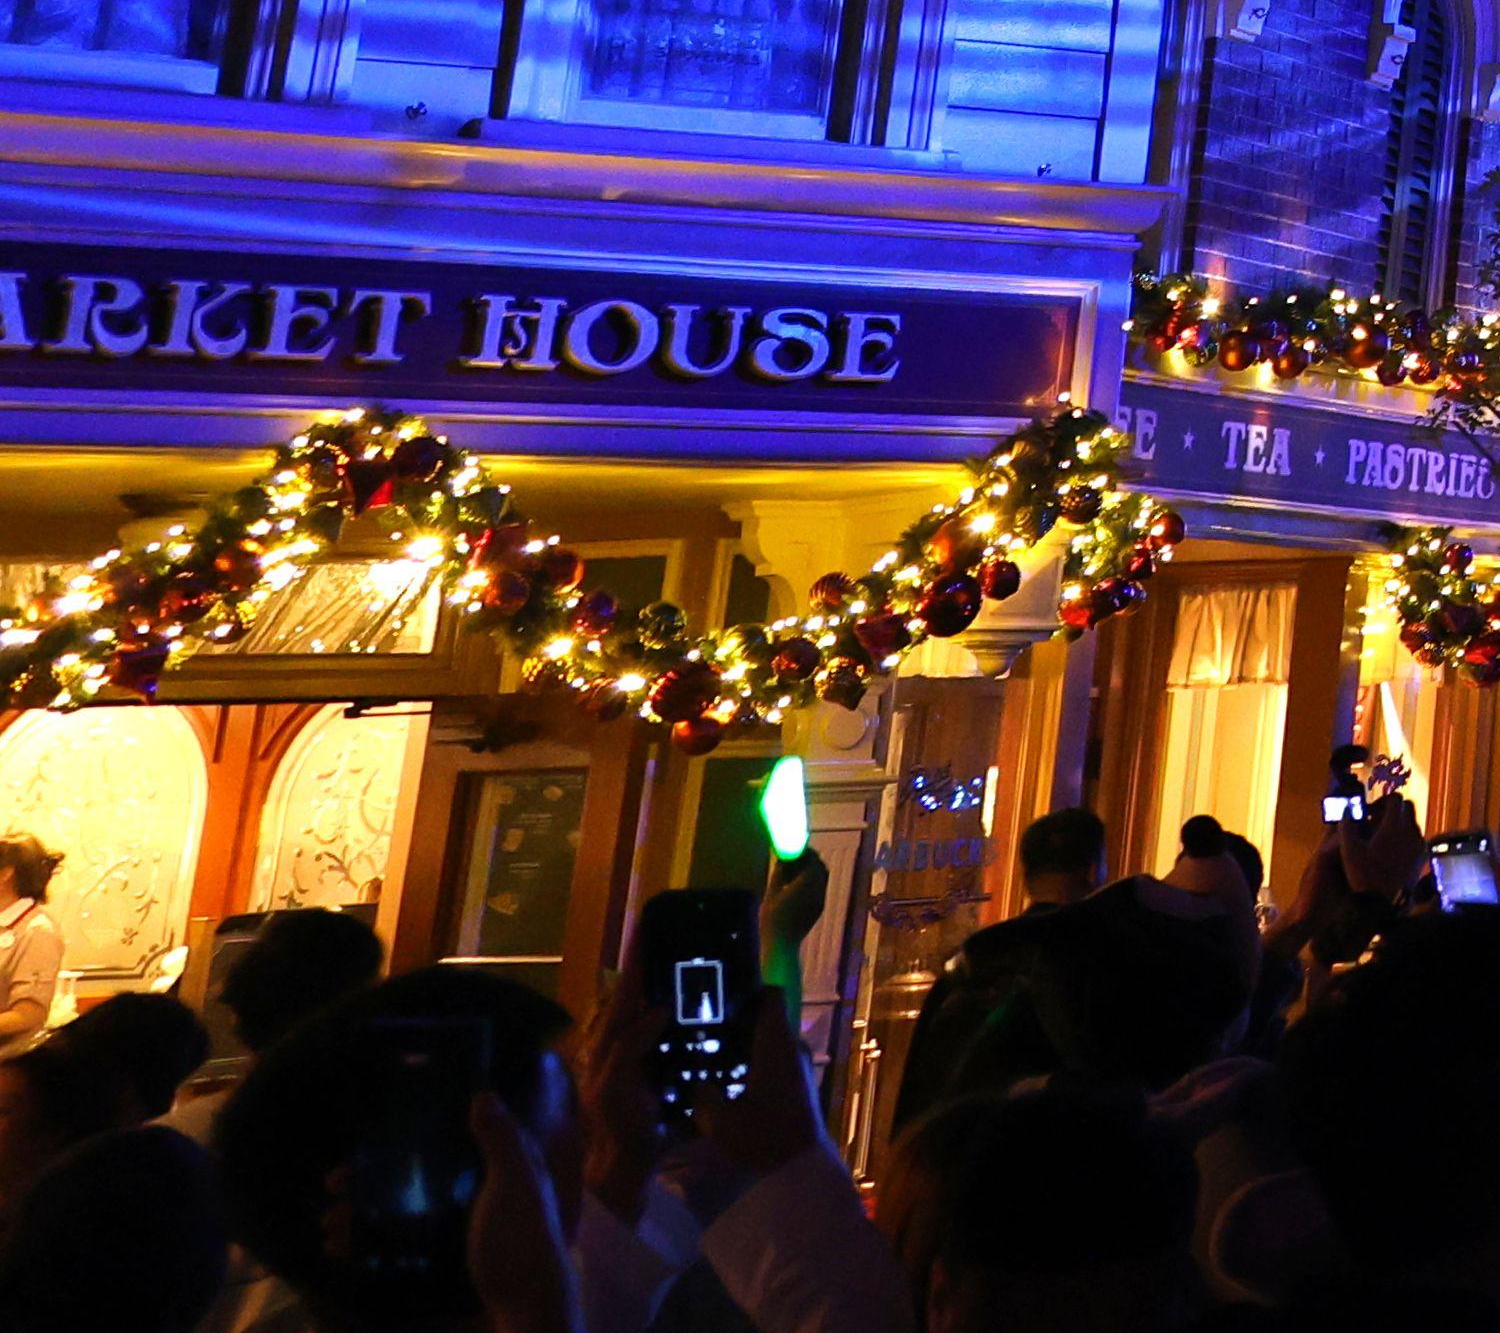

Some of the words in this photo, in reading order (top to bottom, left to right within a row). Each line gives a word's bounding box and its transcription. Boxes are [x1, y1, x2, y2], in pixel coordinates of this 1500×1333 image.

[460, 292, 903, 384] HOUSE
[1220, 420, 1292, 477] TEA
[1344, 438, 1496, 501] PASTRIES
